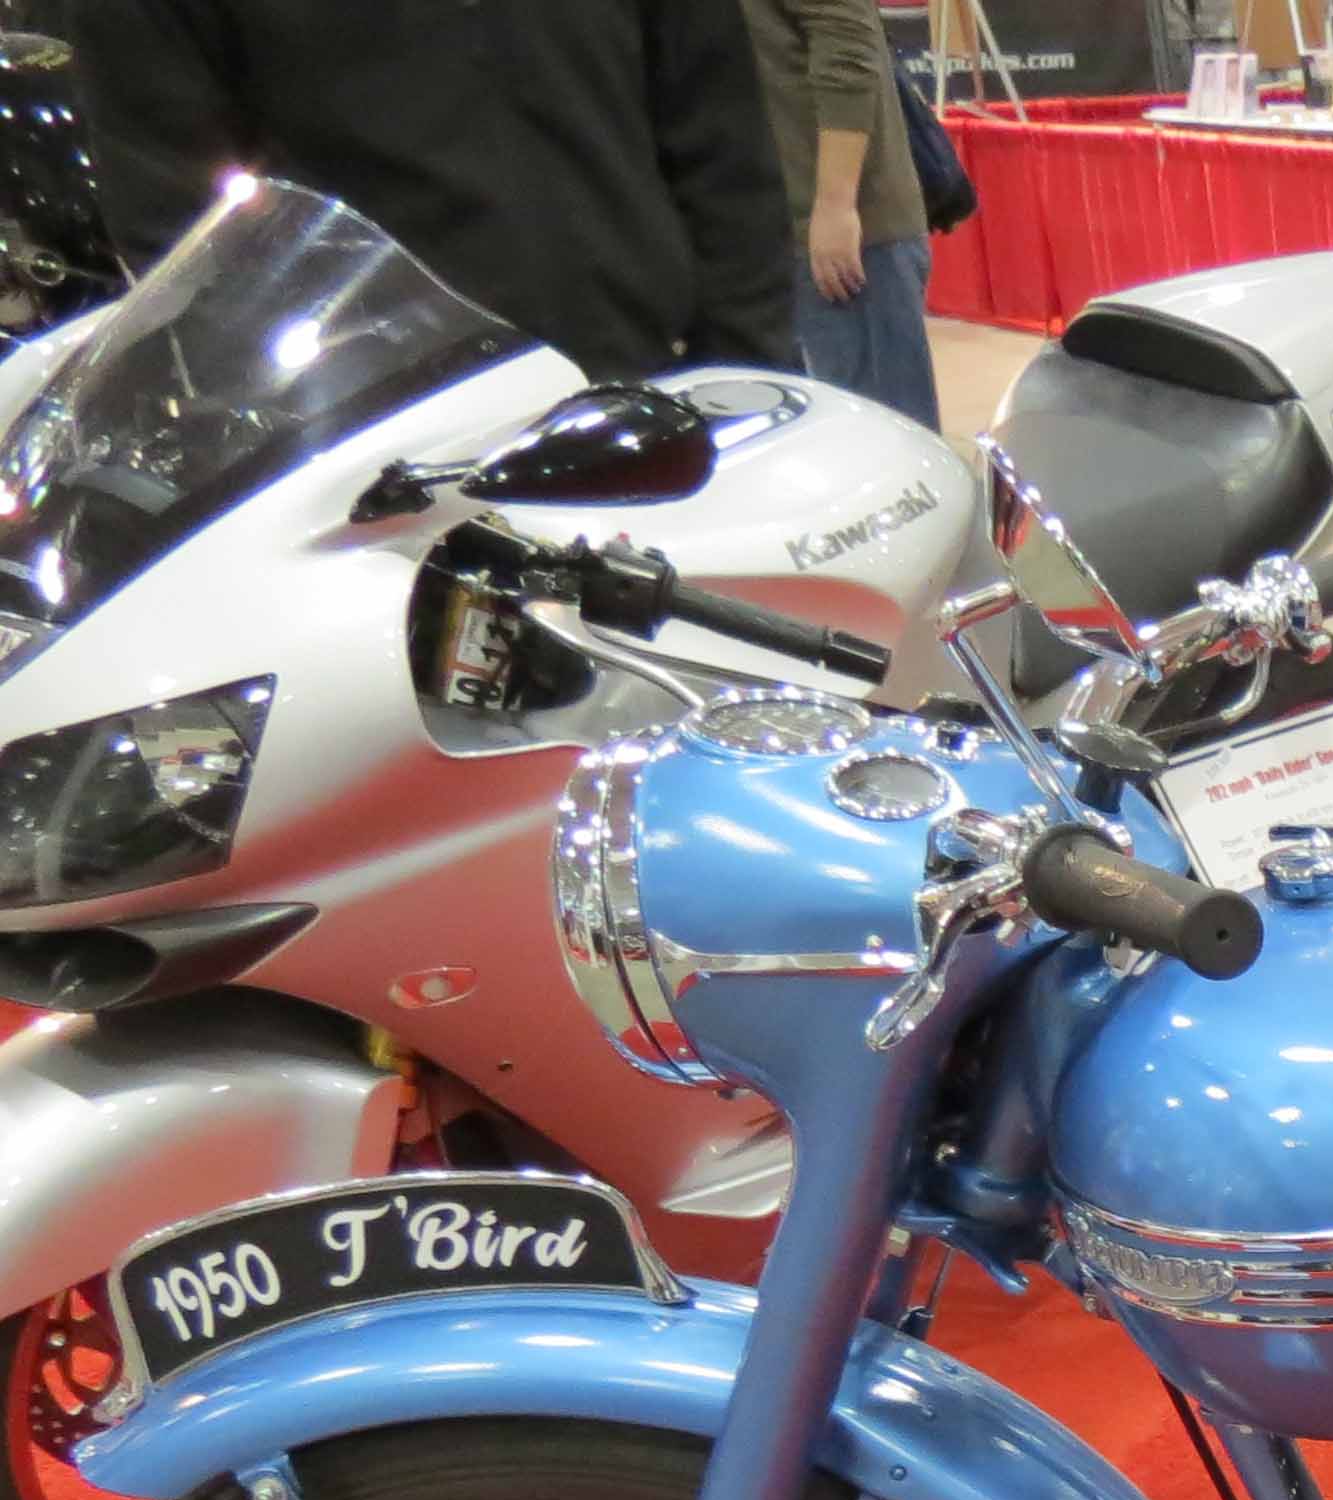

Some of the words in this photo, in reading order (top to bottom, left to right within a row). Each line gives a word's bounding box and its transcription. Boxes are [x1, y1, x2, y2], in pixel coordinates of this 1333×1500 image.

[784, 479, 939, 571] Kawasaki
[152, 1241, 281, 1343] 1950
[322, 1196, 588, 1288] T'Bird
